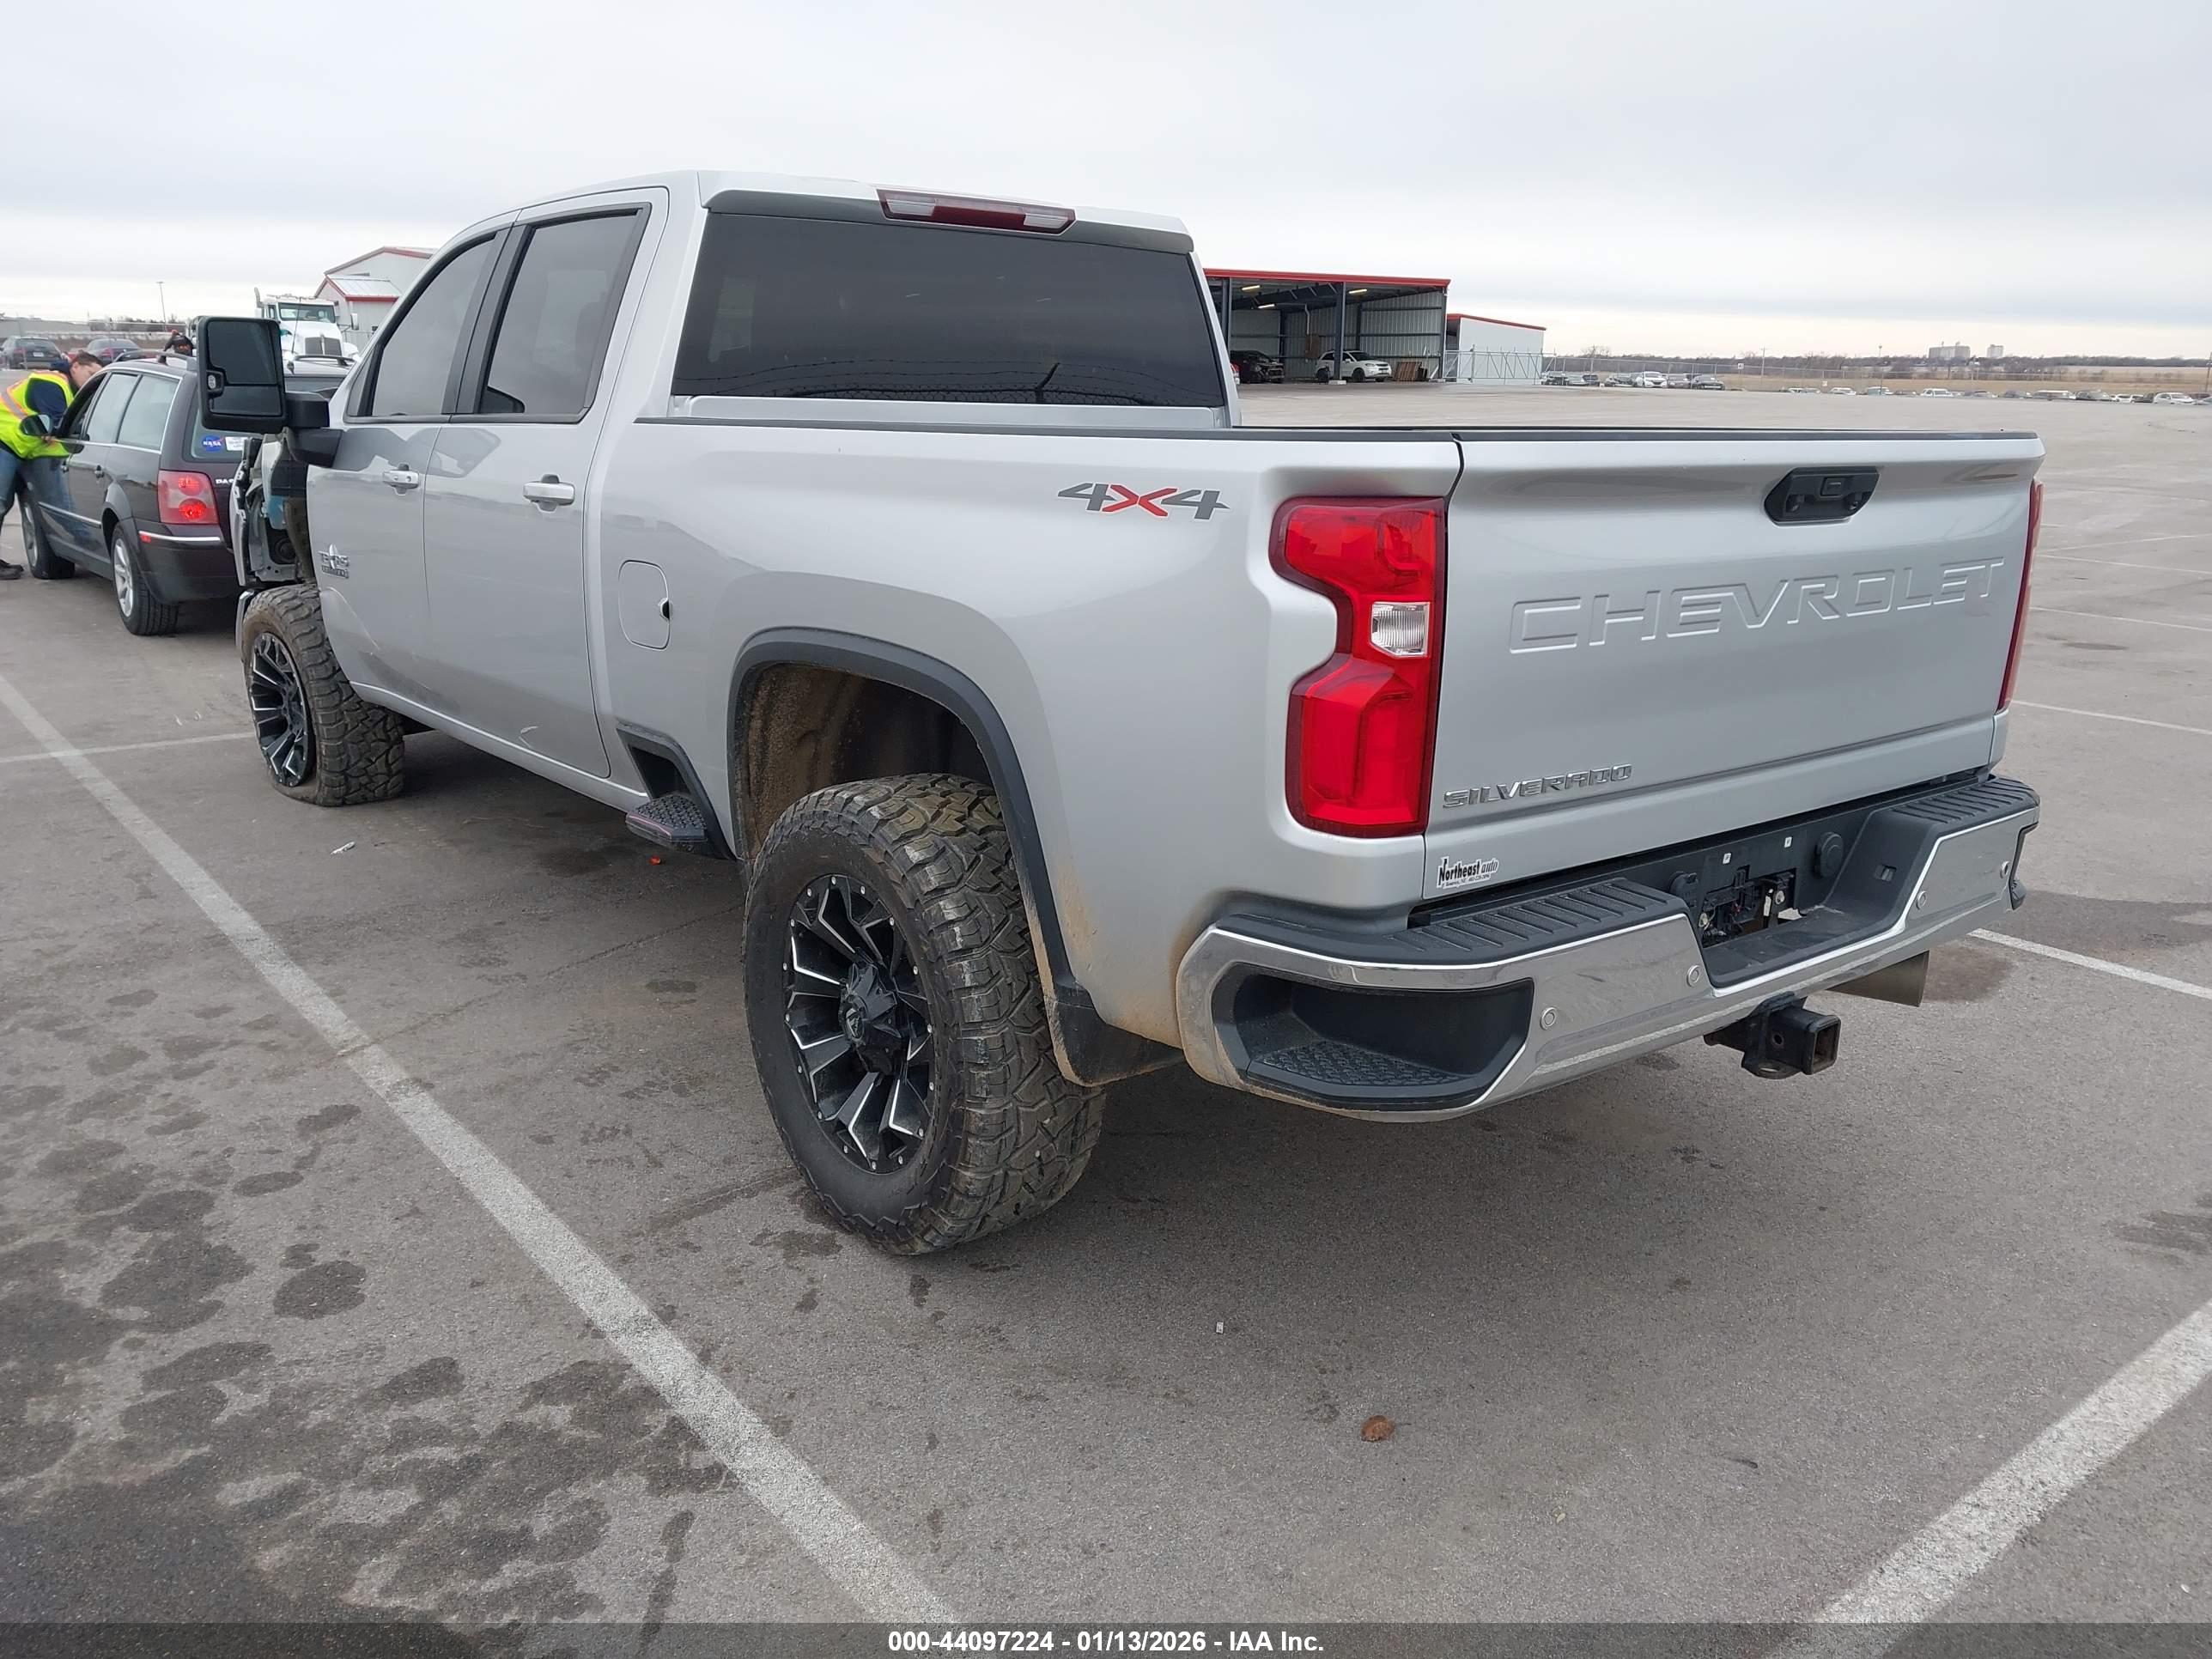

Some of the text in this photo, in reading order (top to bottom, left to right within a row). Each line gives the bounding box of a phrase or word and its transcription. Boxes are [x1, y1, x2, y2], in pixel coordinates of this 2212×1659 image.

[1509, 556, 2005, 654] CHEVROLET
[1443, 763, 1632, 809] SILVERADO
[1438, 858, 1480, 886] Northeast
[1481, 860, 1498, 873] auto
